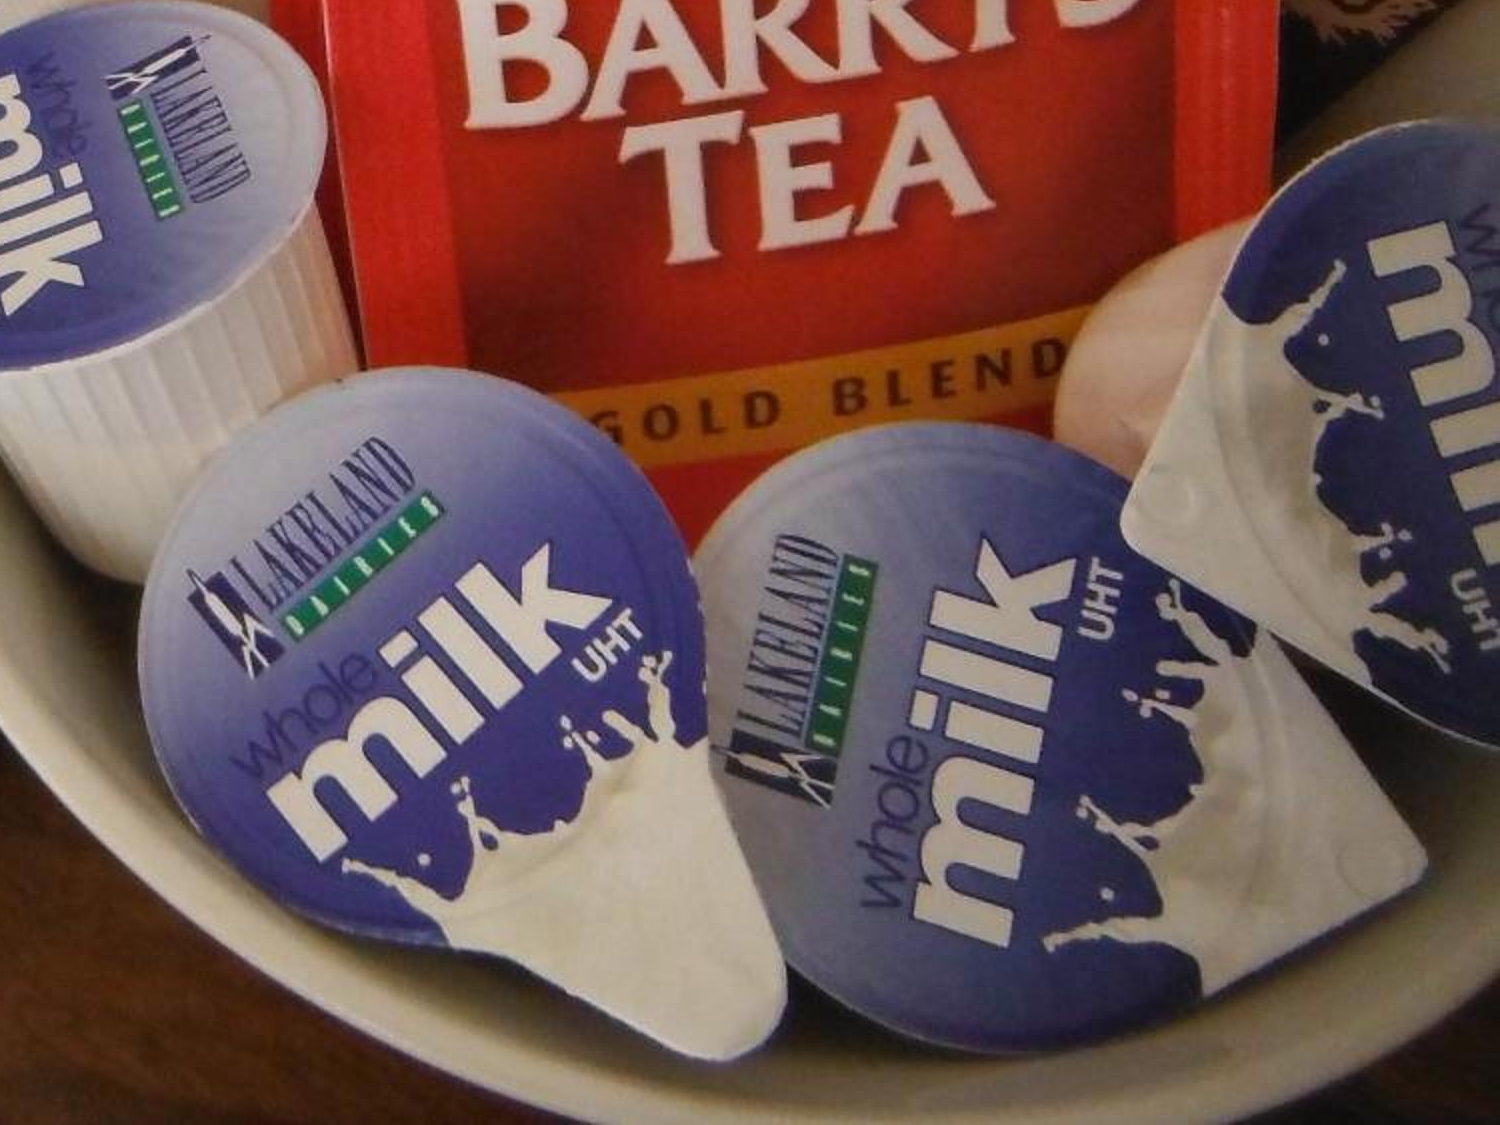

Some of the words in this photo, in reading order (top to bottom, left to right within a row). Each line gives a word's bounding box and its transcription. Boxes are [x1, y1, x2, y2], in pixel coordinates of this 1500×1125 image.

[151, 66, 252, 205] LAKELAND
[617, 94, 997, 264] TEA
[831, 335, 1069, 418] BLEND
[227, 435, 418, 614] LAKELAND
[1076, 556, 1125, 643] UHT
[228, 651, 380, 777] whole
[266, 543, 613, 864] milk
[570, 607, 644, 683] UHT
[735, 533, 840, 737] LAKELAND
[855, 733, 930, 911] whole
[912, 536, 1078, 949] milk
